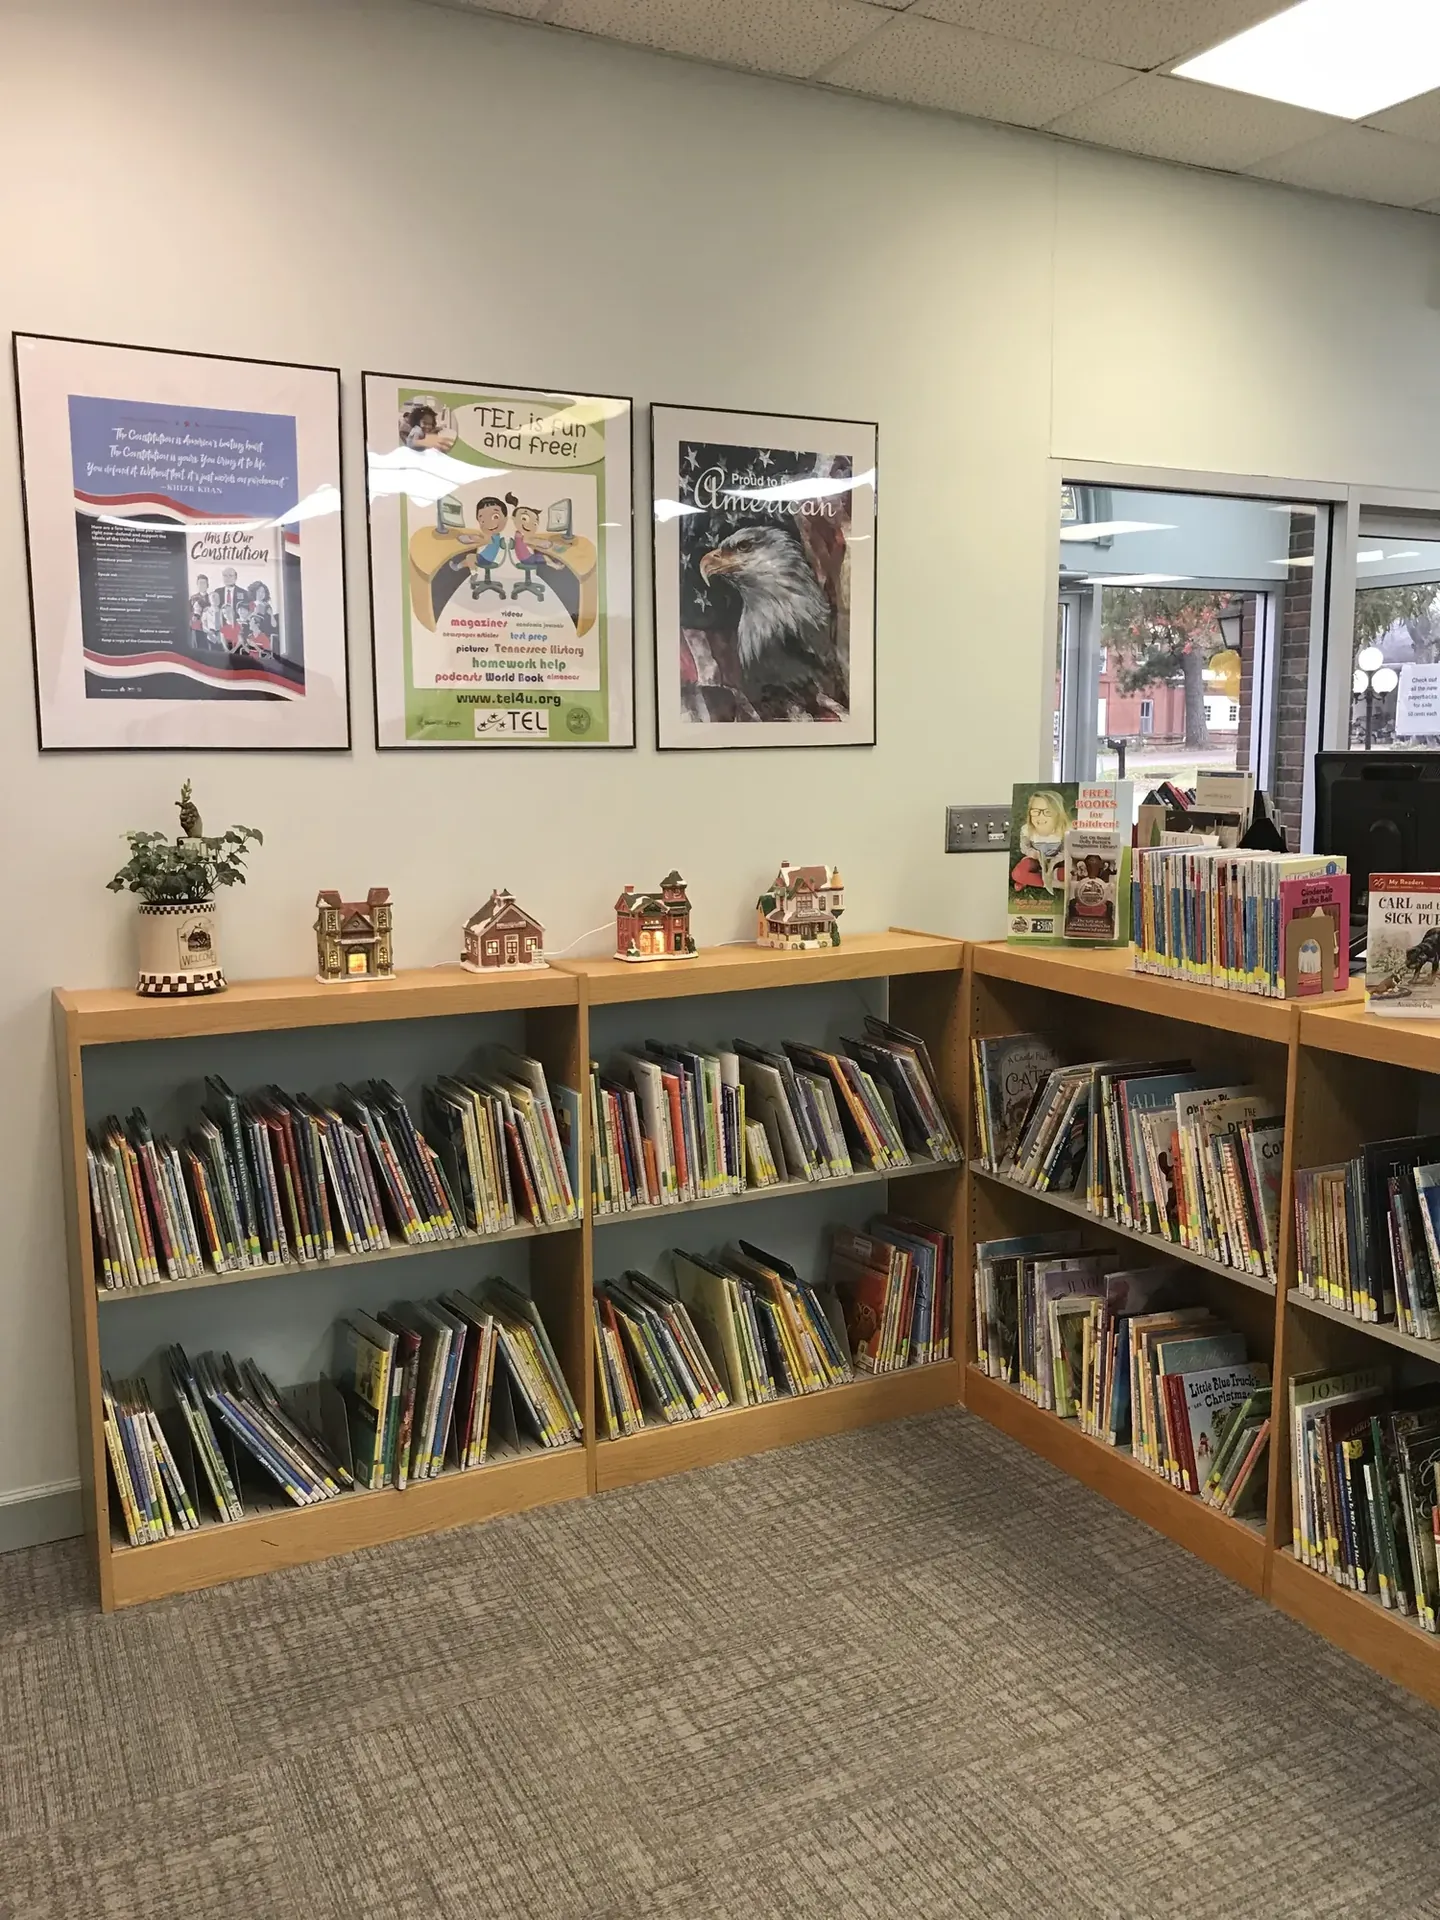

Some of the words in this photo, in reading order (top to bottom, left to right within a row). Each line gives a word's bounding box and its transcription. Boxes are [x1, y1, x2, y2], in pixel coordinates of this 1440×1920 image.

[474, 407, 522, 430] TEL
[530, 413, 542, 431] is
[551, 419, 586, 438] fun
[484, 431, 521, 451] and
[528, 437, 578, 458] free!
[731, 473, 764, 486] Proud
[766, 476, 778, 487] to
[694, 466, 837, 517] American
[204, 531, 221, 545] This
[222, 531, 231, 545] Is
[232, 530, 254, 544] Our
[191, 541, 269, 563] Constitution
[451, 618, 508, 629] magazines
[510, 632, 526, 640] test
[528, 634, 548, 642] prep
[456, 645, 489, 654] pictures
[494, 644, 548, 654] Tennessee
[550, 644, 584, 657] History
[472, 657, 537, 669] homework
[539, 658, 566, 672] help
[435, 672, 482, 683] podcasts
[485, 673, 515, 682] World
[518, 673, 544, 682] Book
[456, 693, 562, 707] www.tel4u.org
[507, 711, 548, 730] TEL
[1082, 789, 1113, 799] FREE
[1075, 800, 1118, 809] BOOKS
[1301, 886, 1334, 897] Cinderella
[1378, 896, 1413, 909] CARL
[1416, 901, 1433, 910] and
[1384, 912, 1412, 925] SICK
[182, 950, 216, 966] WELCOME
[1189, 1381, 1213, 1398] Little
[1212, 1377, 1231, 1391] Blue
[1309, 1370, 1376, 1403] JOSEPH
